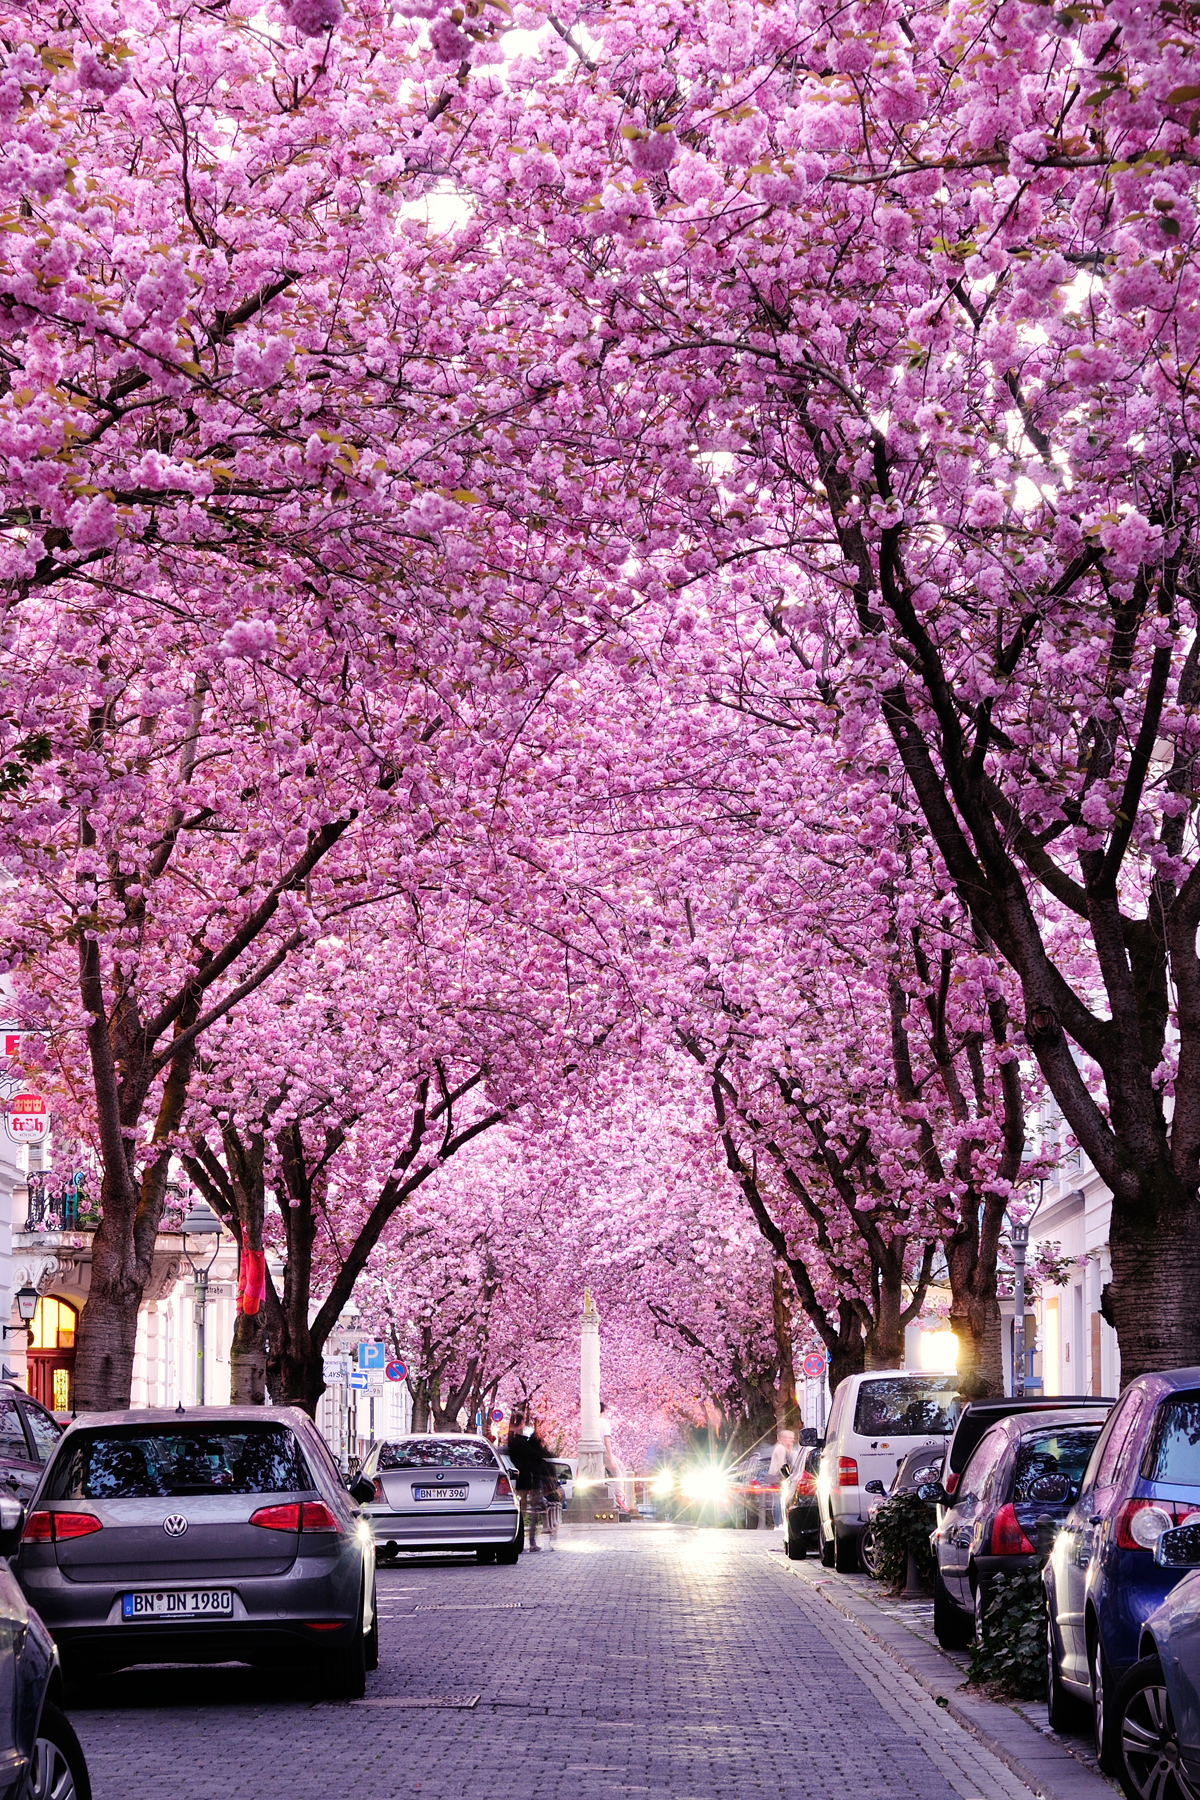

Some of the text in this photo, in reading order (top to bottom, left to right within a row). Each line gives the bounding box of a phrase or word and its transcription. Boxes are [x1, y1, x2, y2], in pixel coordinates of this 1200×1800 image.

[364, 1346, 379, 1366] P
[420, 1489, 464, 1498] BN MY 396
[134, 1592, 230, 1612] BN DN 1980
